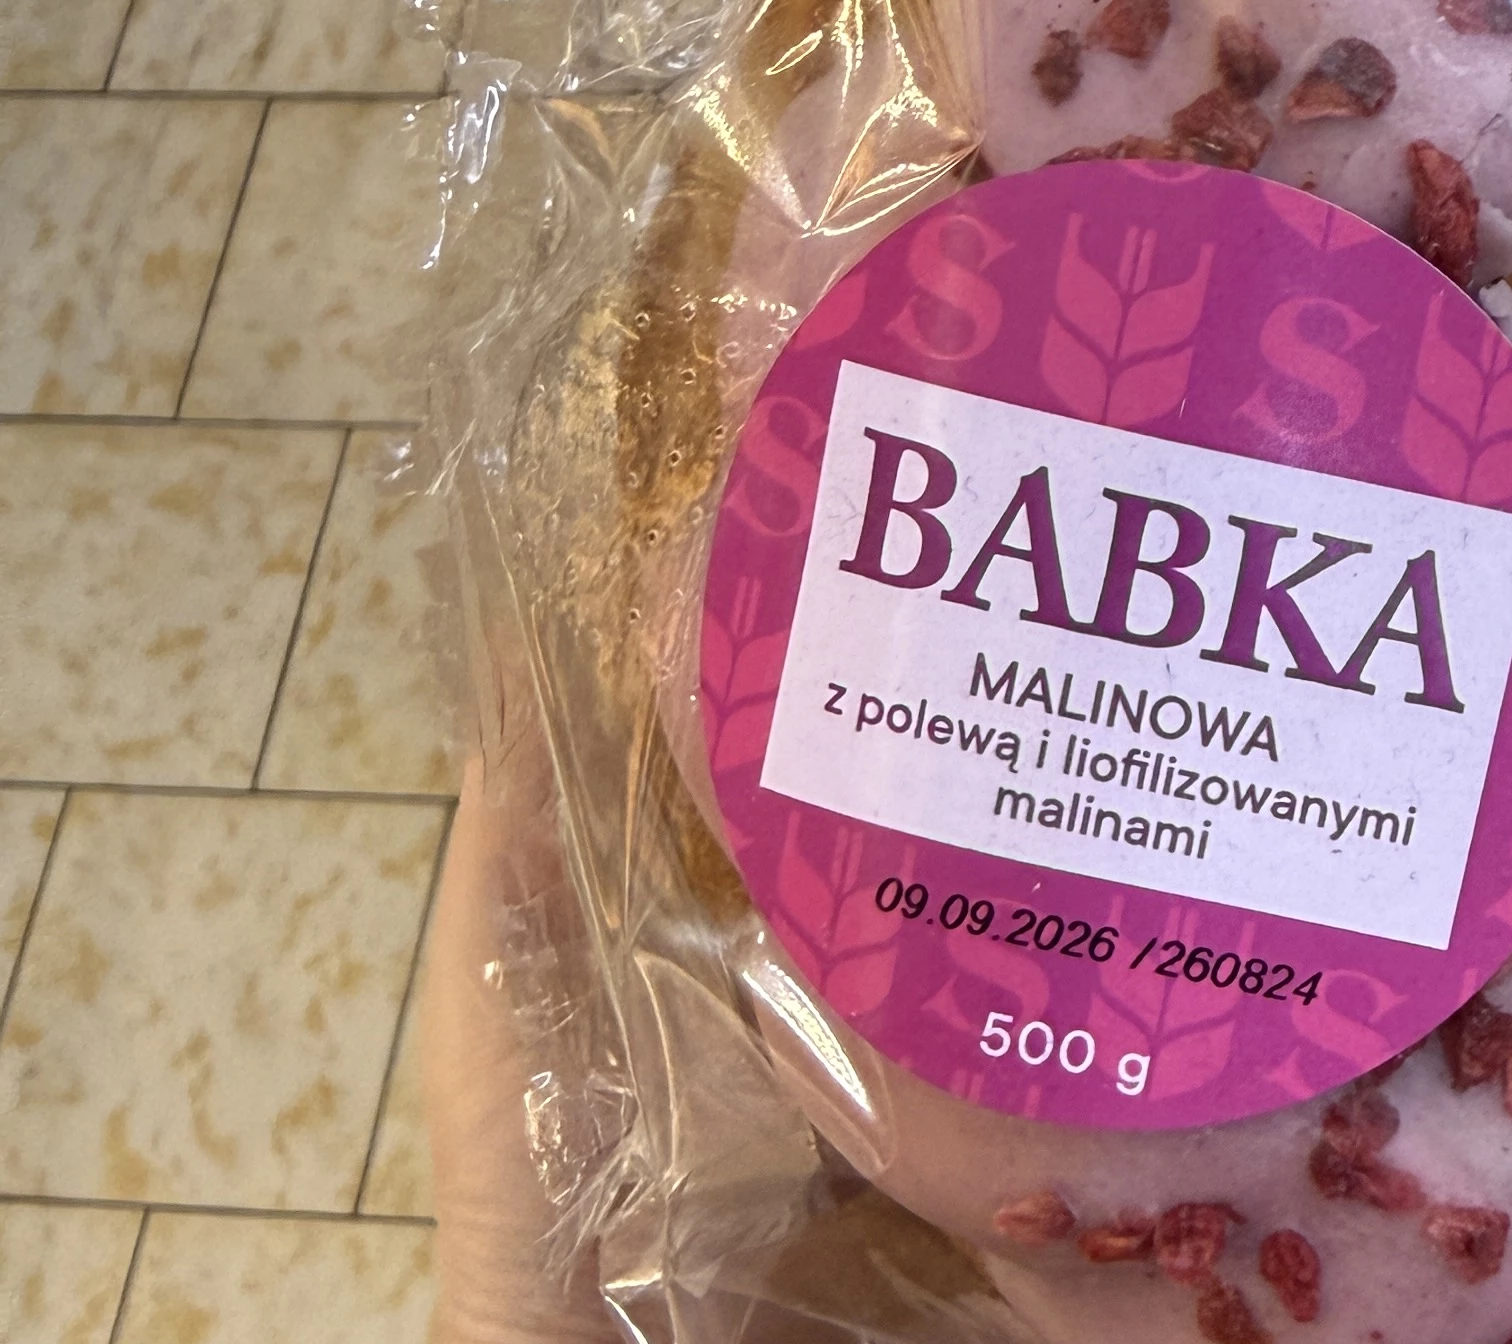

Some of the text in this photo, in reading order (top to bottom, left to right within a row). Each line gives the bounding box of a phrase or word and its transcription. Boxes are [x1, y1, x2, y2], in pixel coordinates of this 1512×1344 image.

[839, 426, 1465, 712] BABKA
[824, 681, 1416, 848] z polewą i liofilizowanymi
[969, 652, 1279, 762] MALINOWA
[994, 785, 1211, 860] malinami
[875, 877, 1323, 1006] 09.09.2026 /260824
[979, 1011, 1151, 1097] 500 g
